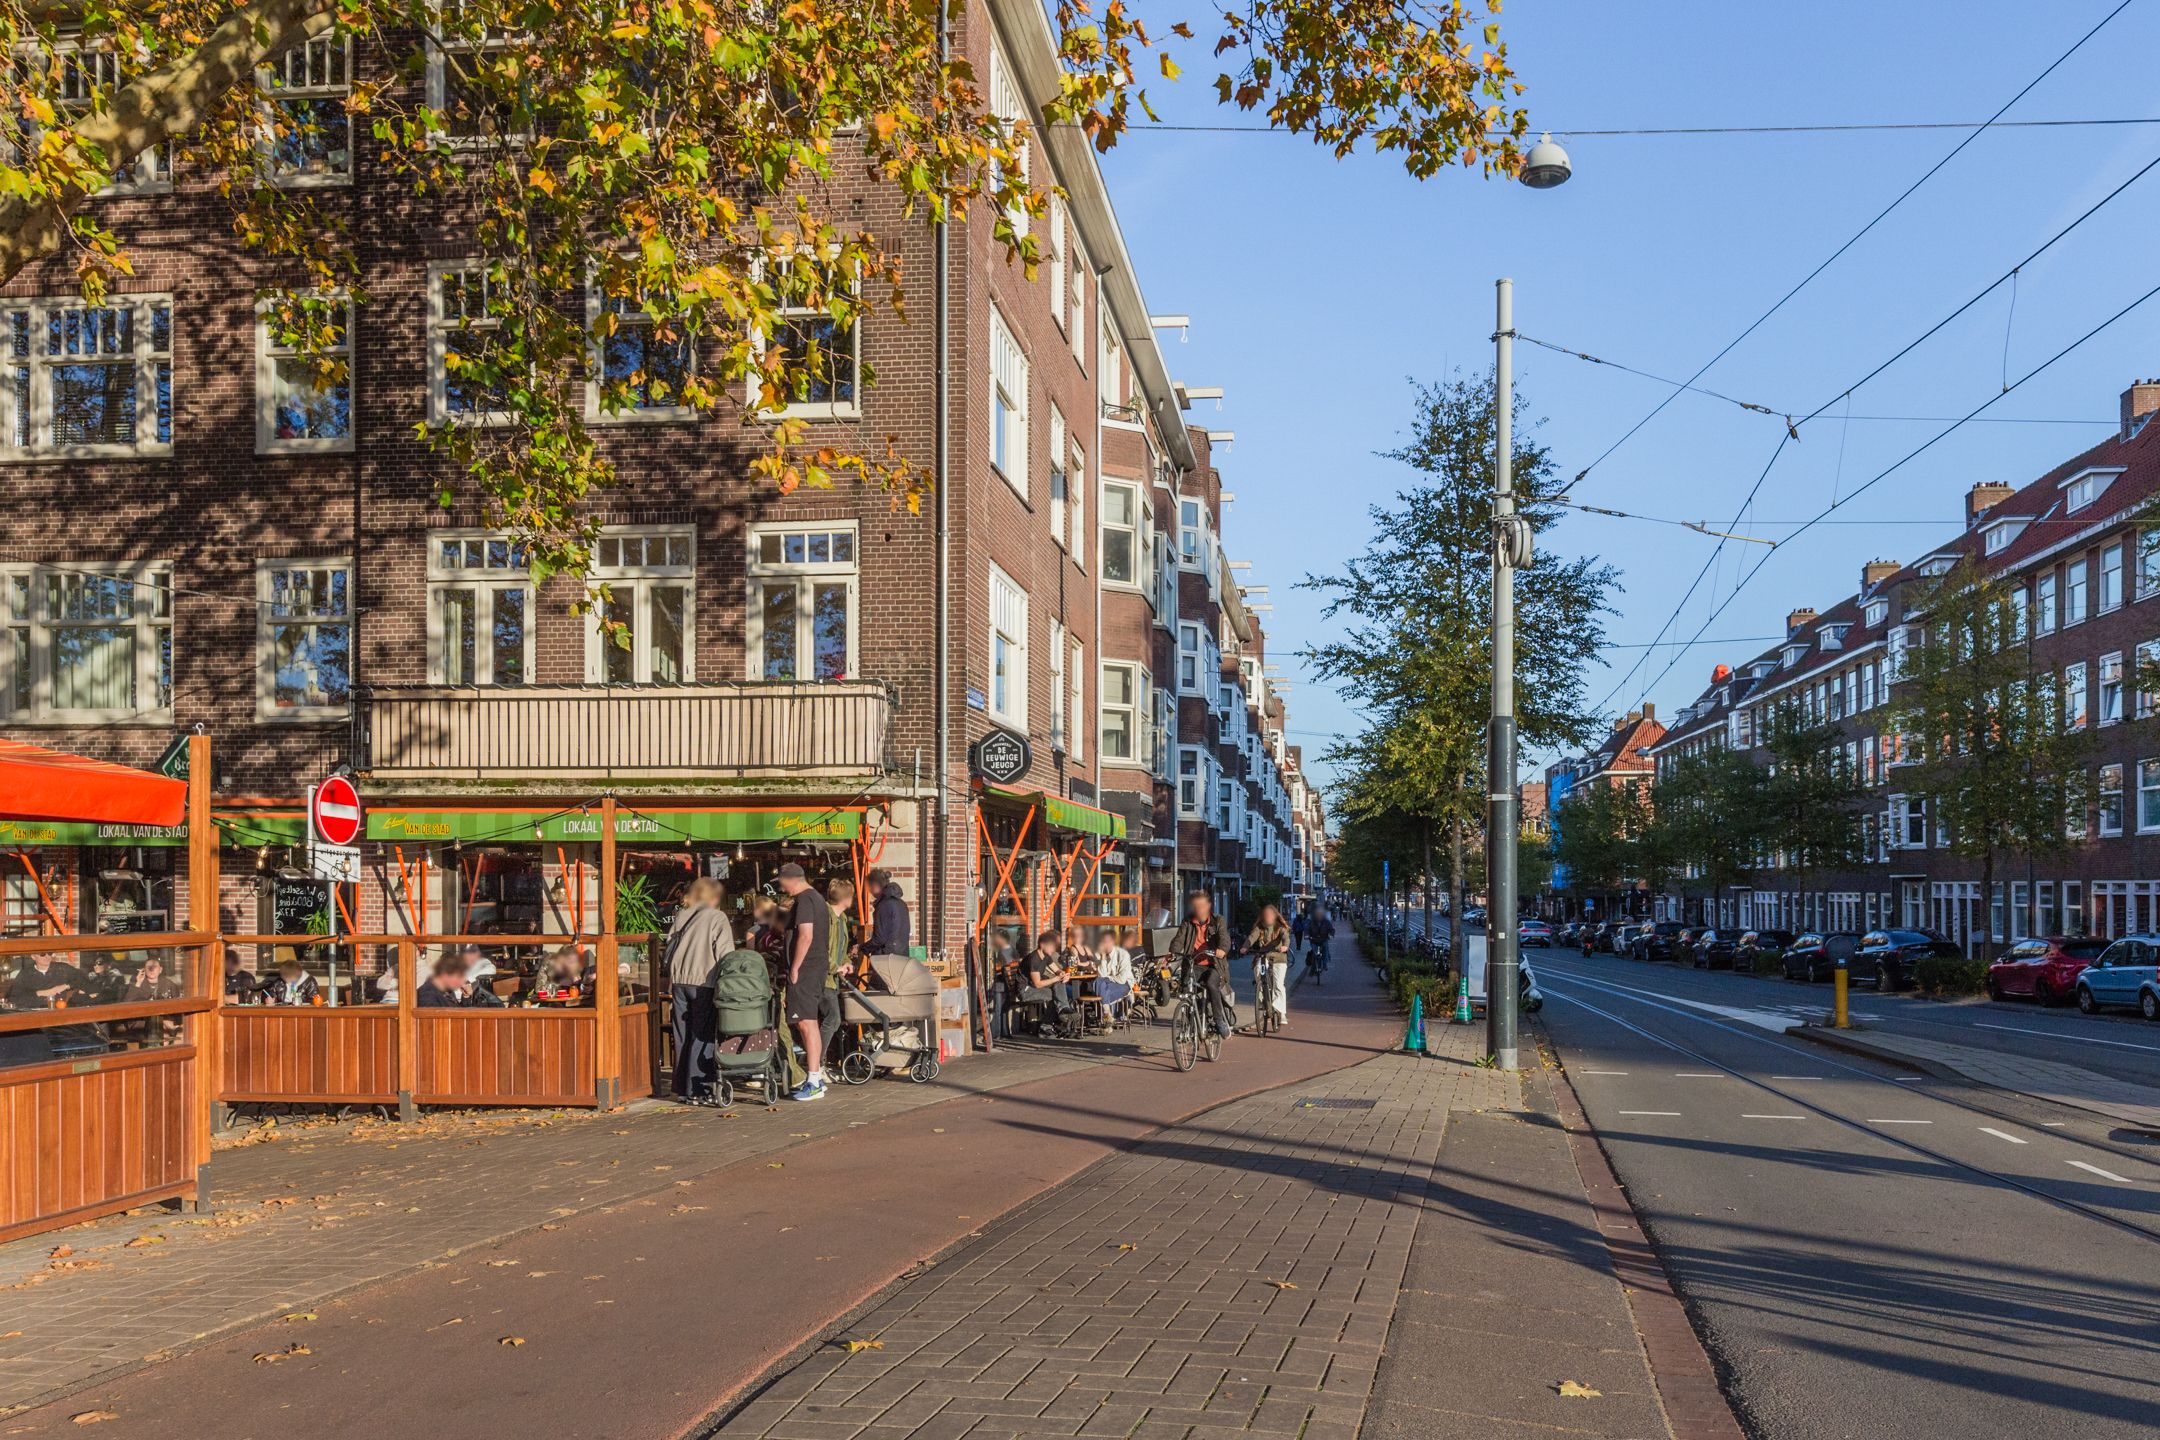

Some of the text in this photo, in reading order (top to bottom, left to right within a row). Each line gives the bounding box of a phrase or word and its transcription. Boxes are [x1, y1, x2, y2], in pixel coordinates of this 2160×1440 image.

[997, 746, 1007, 754] DE
[985, 753, 1019, 762] EEUWIGE
[990, 761, 1015, 769] JEUGD
[98, 825, 188, 838] LOKAAL VAN DE STAD
[405, 823, 450, 835] VAN DE STAD
[563, 820, 598, 833] LOKAAL
[621, 820, 632, 833] DE
[797, 822, 814, 835] VAN
[815, 823, 825, 834] DE
[13, 828, 27, 840] VAN
[40, 829, 57, 840] STAD
[930, 965, 945, 973] SHOP
